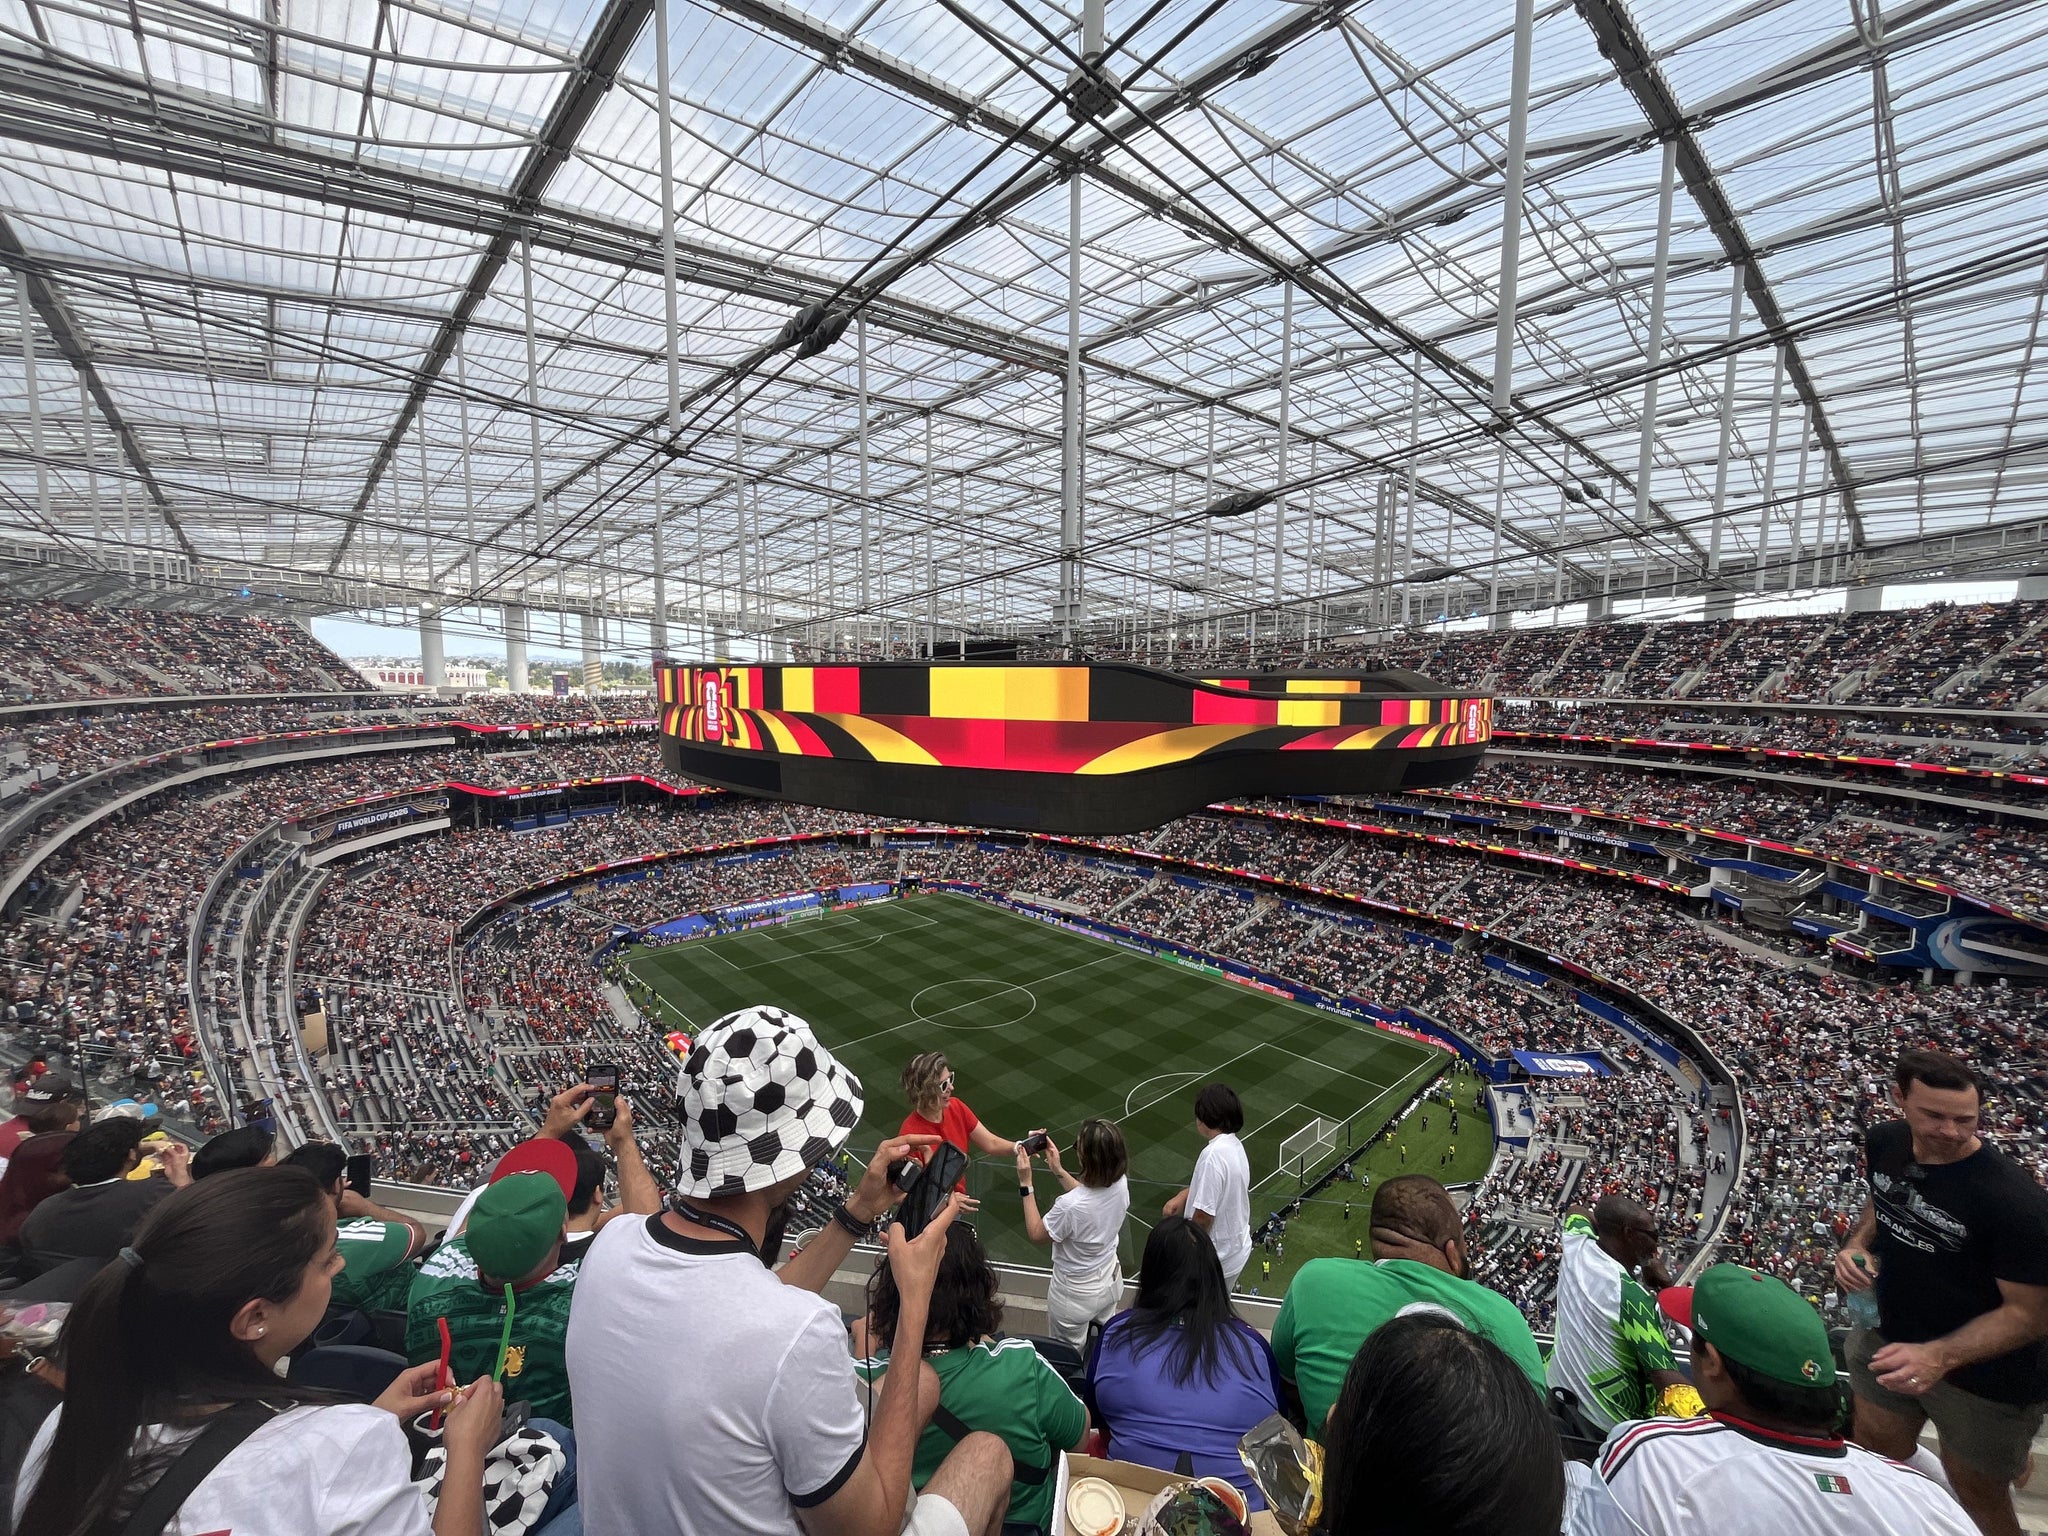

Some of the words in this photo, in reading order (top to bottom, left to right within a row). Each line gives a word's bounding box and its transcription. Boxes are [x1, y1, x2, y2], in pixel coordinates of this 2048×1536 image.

[338, 821, 353, 831] FIFA
[353, 816, 375, 827] WORLD
[376, 812, 388, 821] CUP
[389, 808, 408, 818] 2026
[1569, 831, 1591, 840] WORLD
[1592, 835, 1604, 843] CUP
[1605, 839, 1629, 848] 2026
[744, 901, 772, 910] WORLD
[789, 893, 815, 902] 2026
[1178, 958, 1204, 972] aramco
[1326, 1006, 1351, 1018] HYUNDAI
[1623, 1015, 1635, 1026] LOS
[1389, 1024, 1416, 1039] Lenovo
[1429, 1036, 1453, 1053] Lenovo
[1876, 1210, 1891, 1227] LOS
